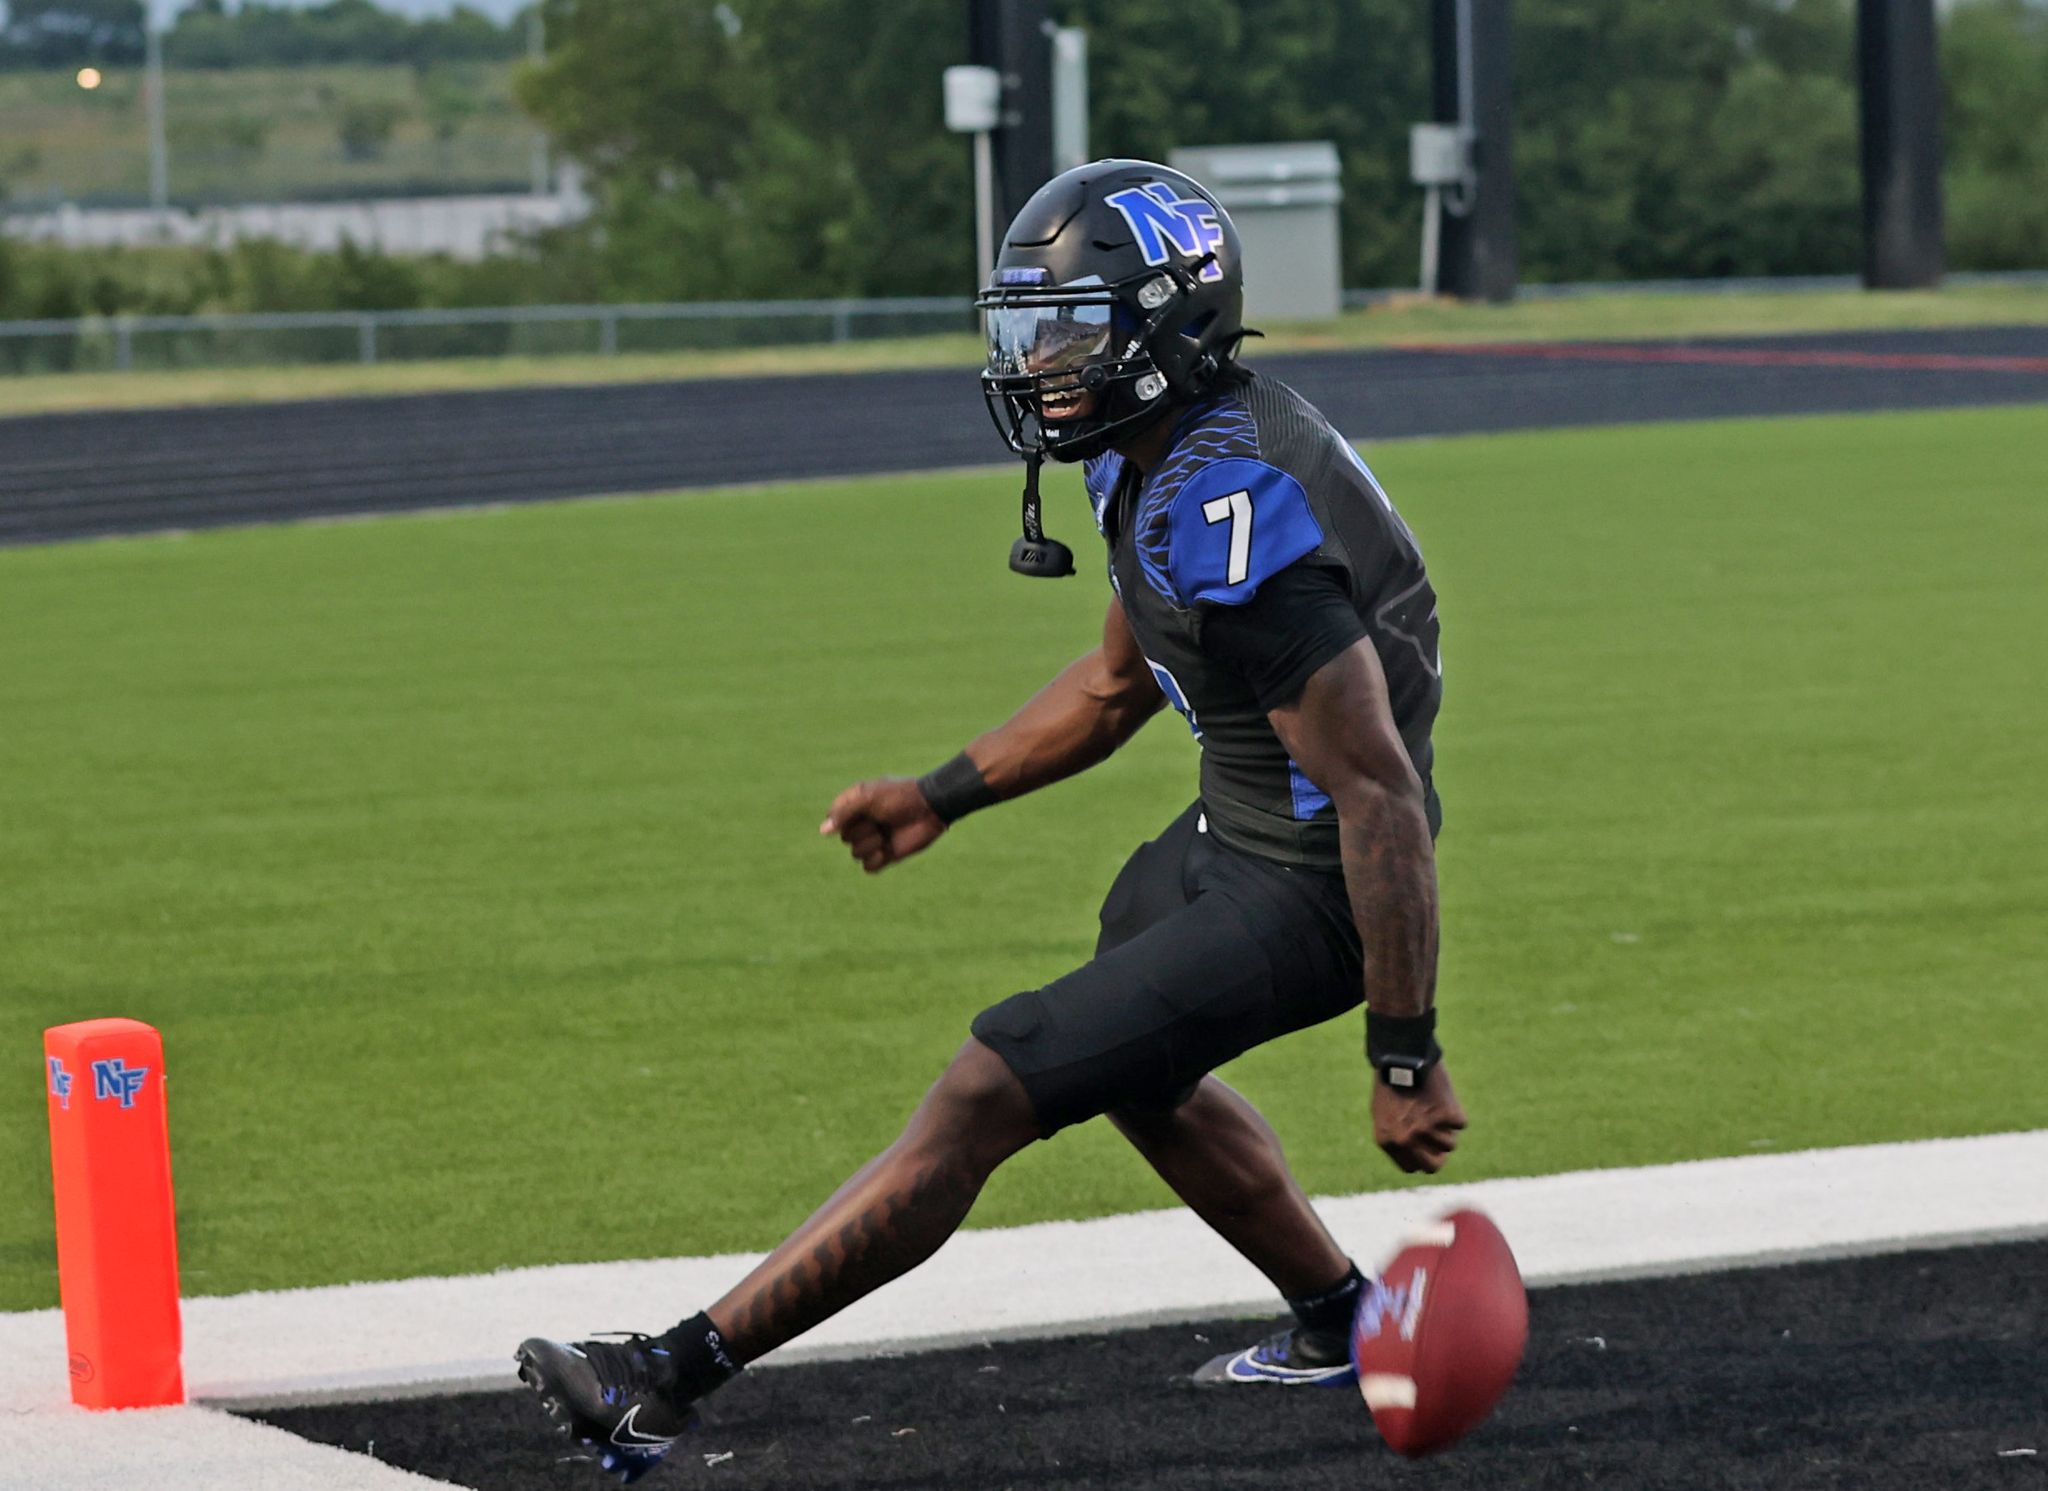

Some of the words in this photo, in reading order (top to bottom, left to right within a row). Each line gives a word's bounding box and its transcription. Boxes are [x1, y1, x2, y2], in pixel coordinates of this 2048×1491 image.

[1103, 181, 1224, 284] NF
[1201, 488, 1254, 587] 7
[91, 1057, 150, 1108] NF
